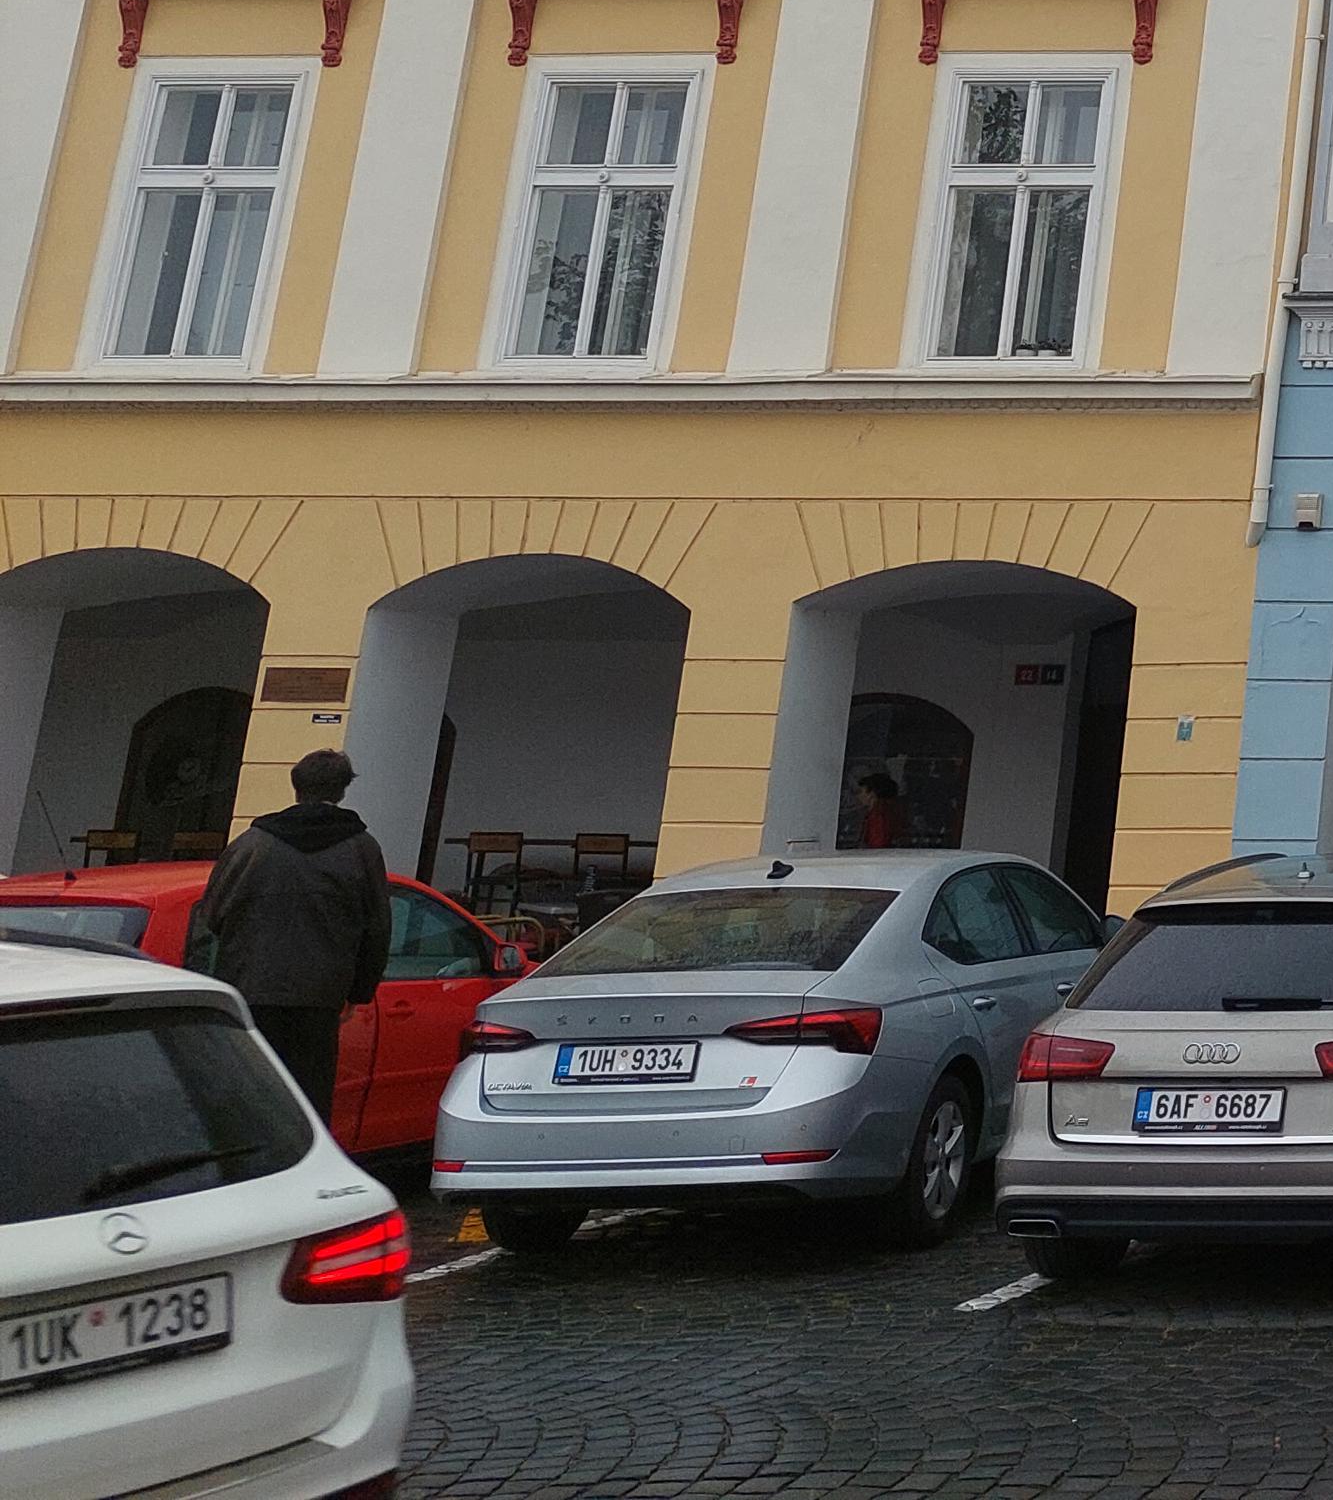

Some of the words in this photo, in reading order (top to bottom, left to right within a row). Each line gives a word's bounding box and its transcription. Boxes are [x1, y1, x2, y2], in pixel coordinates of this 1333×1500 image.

[579, 1049, 616, 1073] 1UH
[632, 1047, 684, 1071] 9334
[1137, 1110, 1150, 1119] CZ
[1154, 1093, 1199, 1119] 6AF
[1214, 1093, 1273, 1119] 6687
[8, 1312, 83, 1370] 1UK
[118, 1288, 211, 1347] 1238
